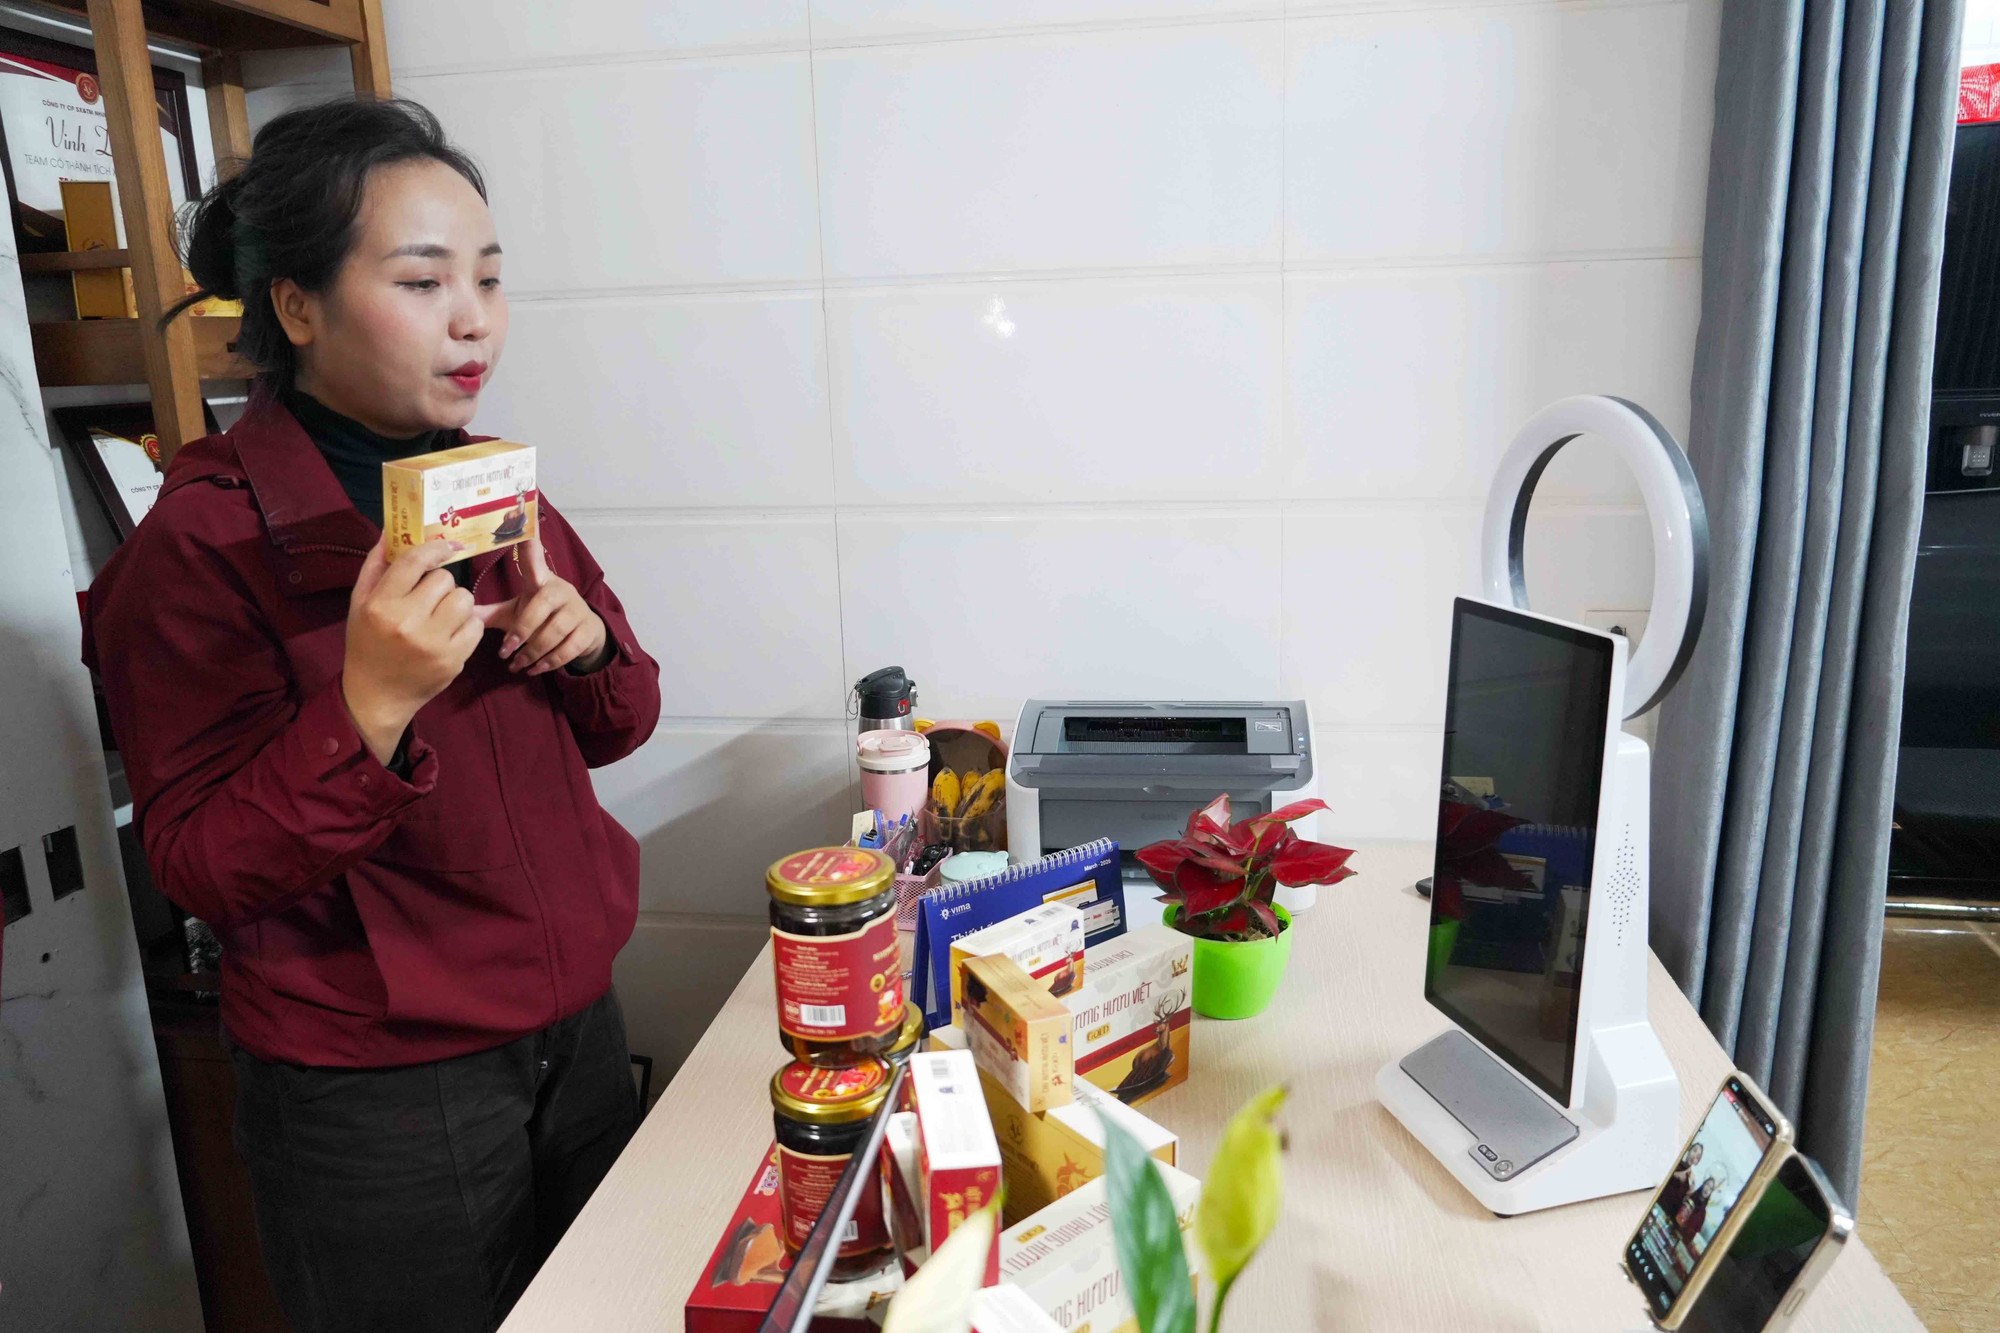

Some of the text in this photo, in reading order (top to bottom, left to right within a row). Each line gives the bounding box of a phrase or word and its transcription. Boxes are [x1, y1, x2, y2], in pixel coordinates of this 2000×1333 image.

[45, 115, 86, 153] Vinh
[24, 154, 48, 166] TEAM
[50, 157, 65, 169] CÓ
[1084, 863, 1098, 872] March
[1074, 981, 1153, 1032] ƯƠNG HƯƠU VIỆT
[1087, 1024, 1110, 1041] GOLD
[1077, 1269, 1119, 1320] HƯƠU
